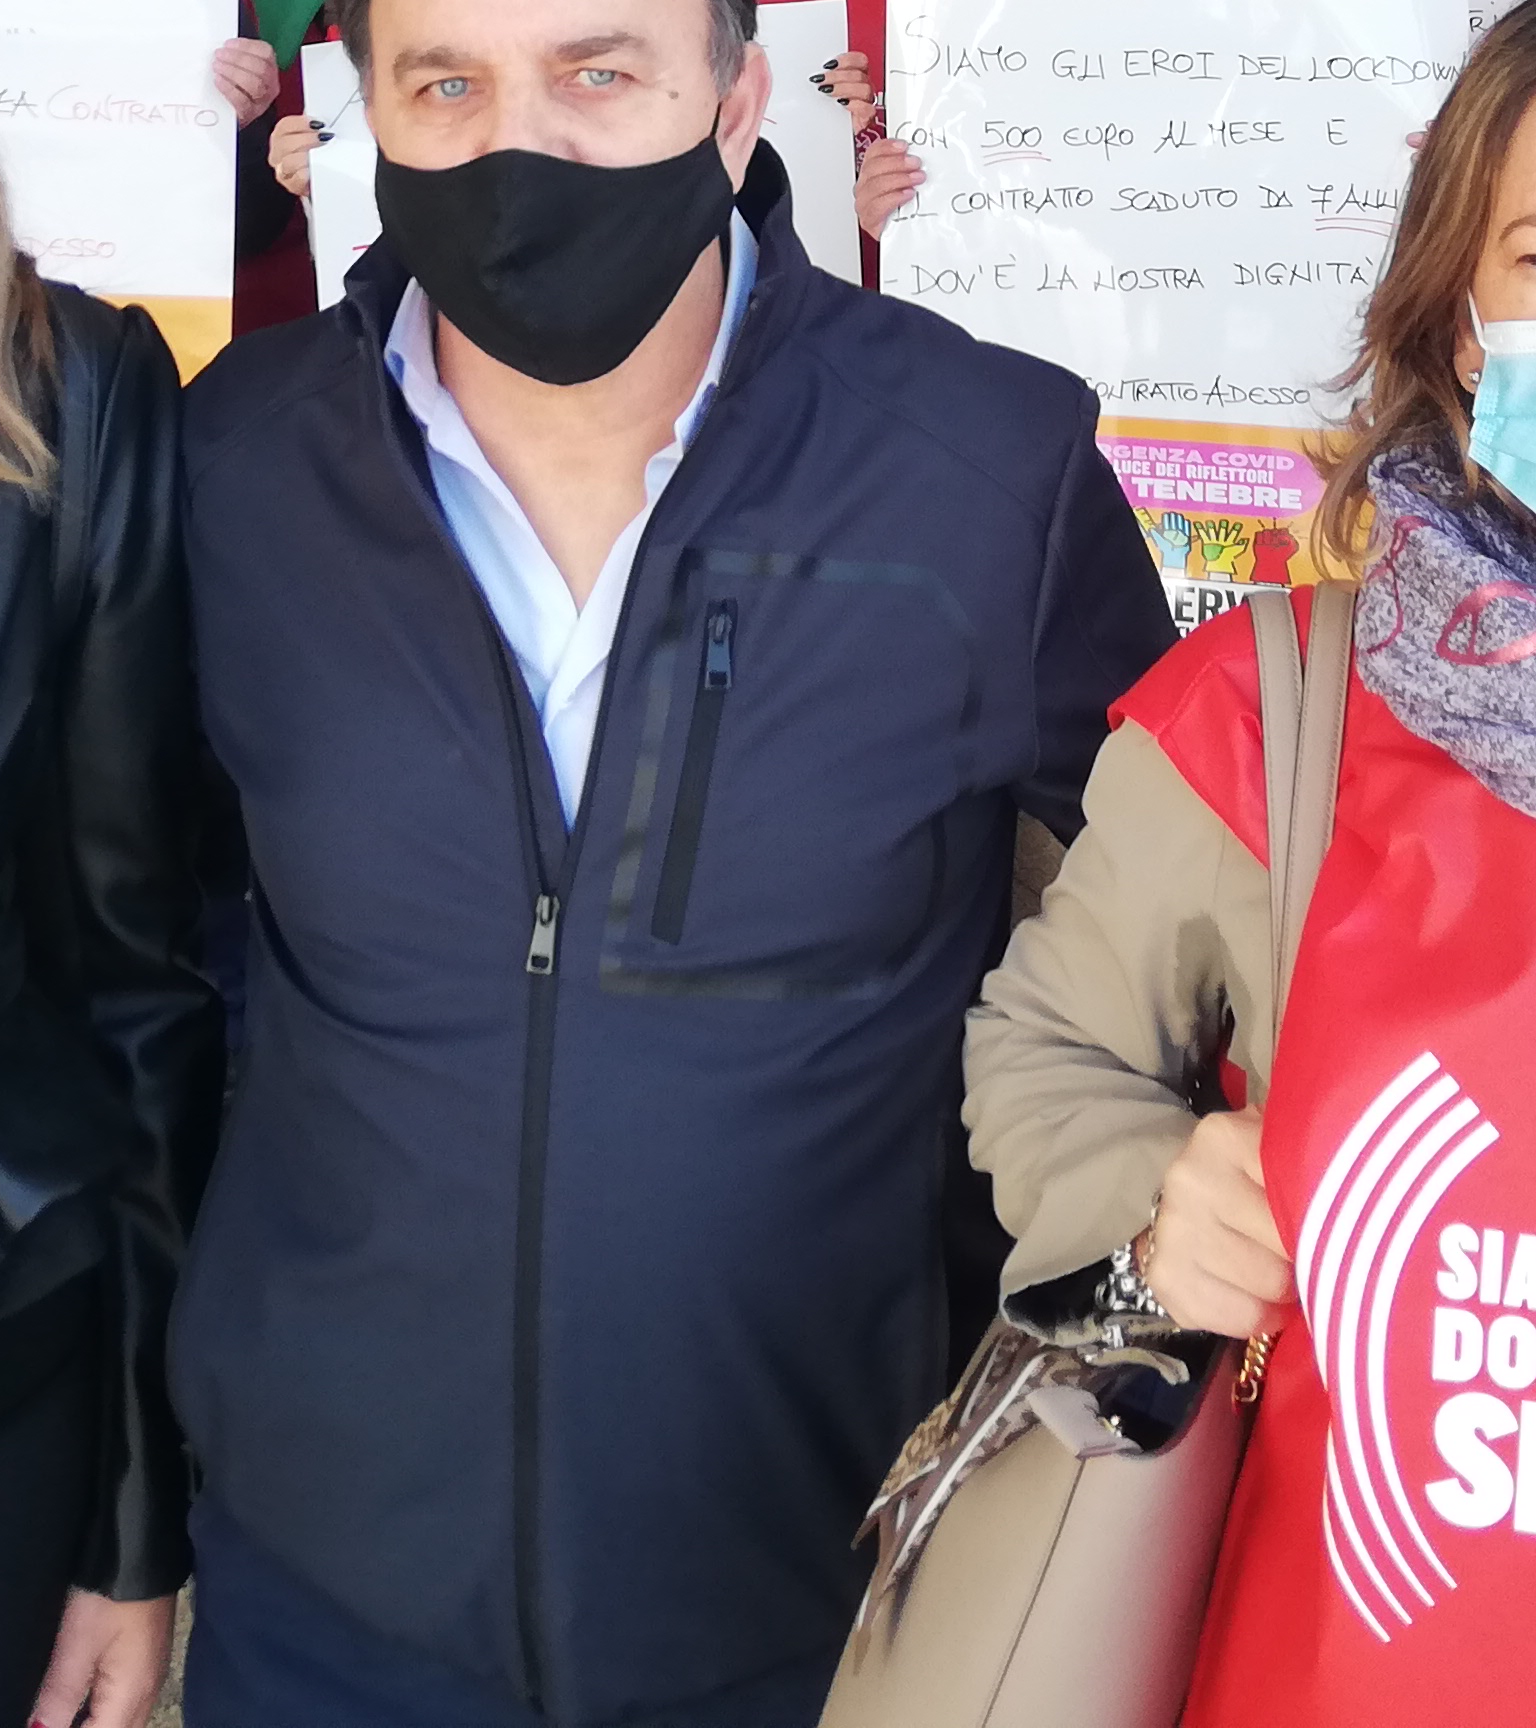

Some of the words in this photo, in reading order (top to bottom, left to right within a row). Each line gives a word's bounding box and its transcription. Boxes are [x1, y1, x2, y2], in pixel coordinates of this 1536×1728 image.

[889, 15, 1027, 78] SIAMO
[1052, 49, 1105, 81] GLI
[1124, 47, 1222, 80] EROI
[46, 84, 220, 127] CONTRATTO
[980, 120, 1043, 149] 500
[1063, 122, 1135, 161] EURO
[1154, 119, 1197, 153] AL
[1326, 118, 1348, 146] E
[950, 186, 1094, 214] CONTRATTO
[1110, 186, 1238, 213] SCADUTO
[1258, 184, 1293, 209] DA
[1036, 262, 1077, 291] LA
[1093, 266, 1205, 293] NOSTRA
[1233, 255, 1374, 289] DIGNITÀ
[1155, 461, 1181, 478] DEI
[1185, 463, 1274, 485] RIFLETTORI
[1211, 450, 1296, 471] COVID
[1130, 476, 1303, 511] TENEBRE
